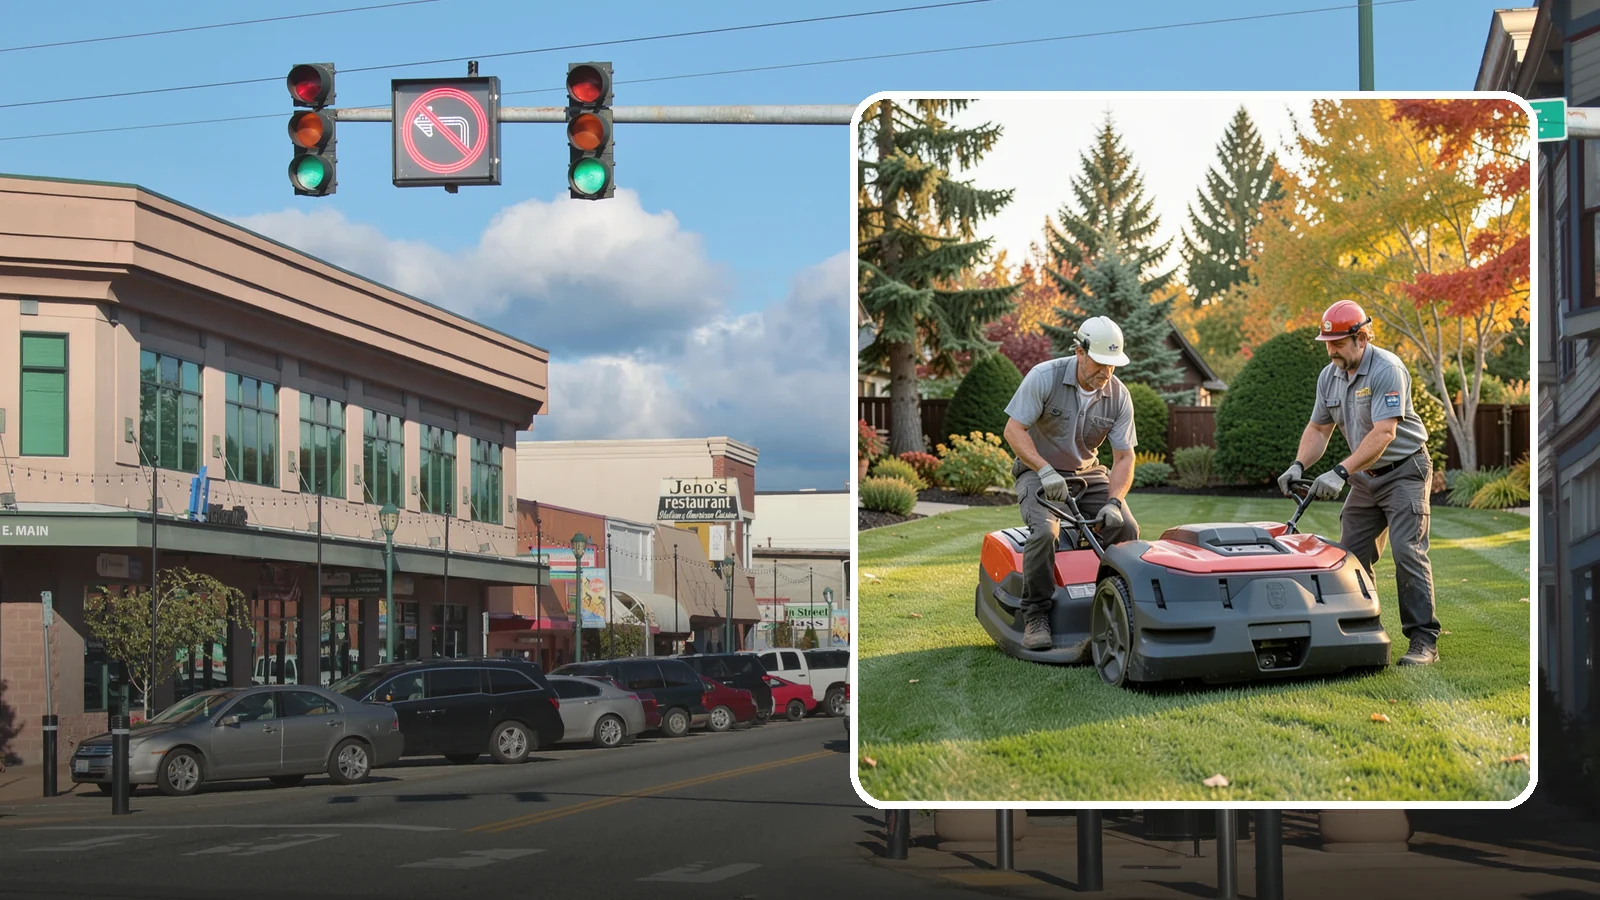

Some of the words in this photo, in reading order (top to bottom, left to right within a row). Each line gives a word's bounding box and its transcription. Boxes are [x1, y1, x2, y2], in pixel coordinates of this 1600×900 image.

[669, 480, 727, 494] Jeno's
[665, 496, 731, 509] restaurant
[658, 509, 681, 519] Italian
[685, 509, 715, 519] American
[714, 509, 738, 519] Cuisine
[2, 525, 13, 536] E.
[15, 525, 49, 536] MAIN
[797, 608, 828, 616] Street
